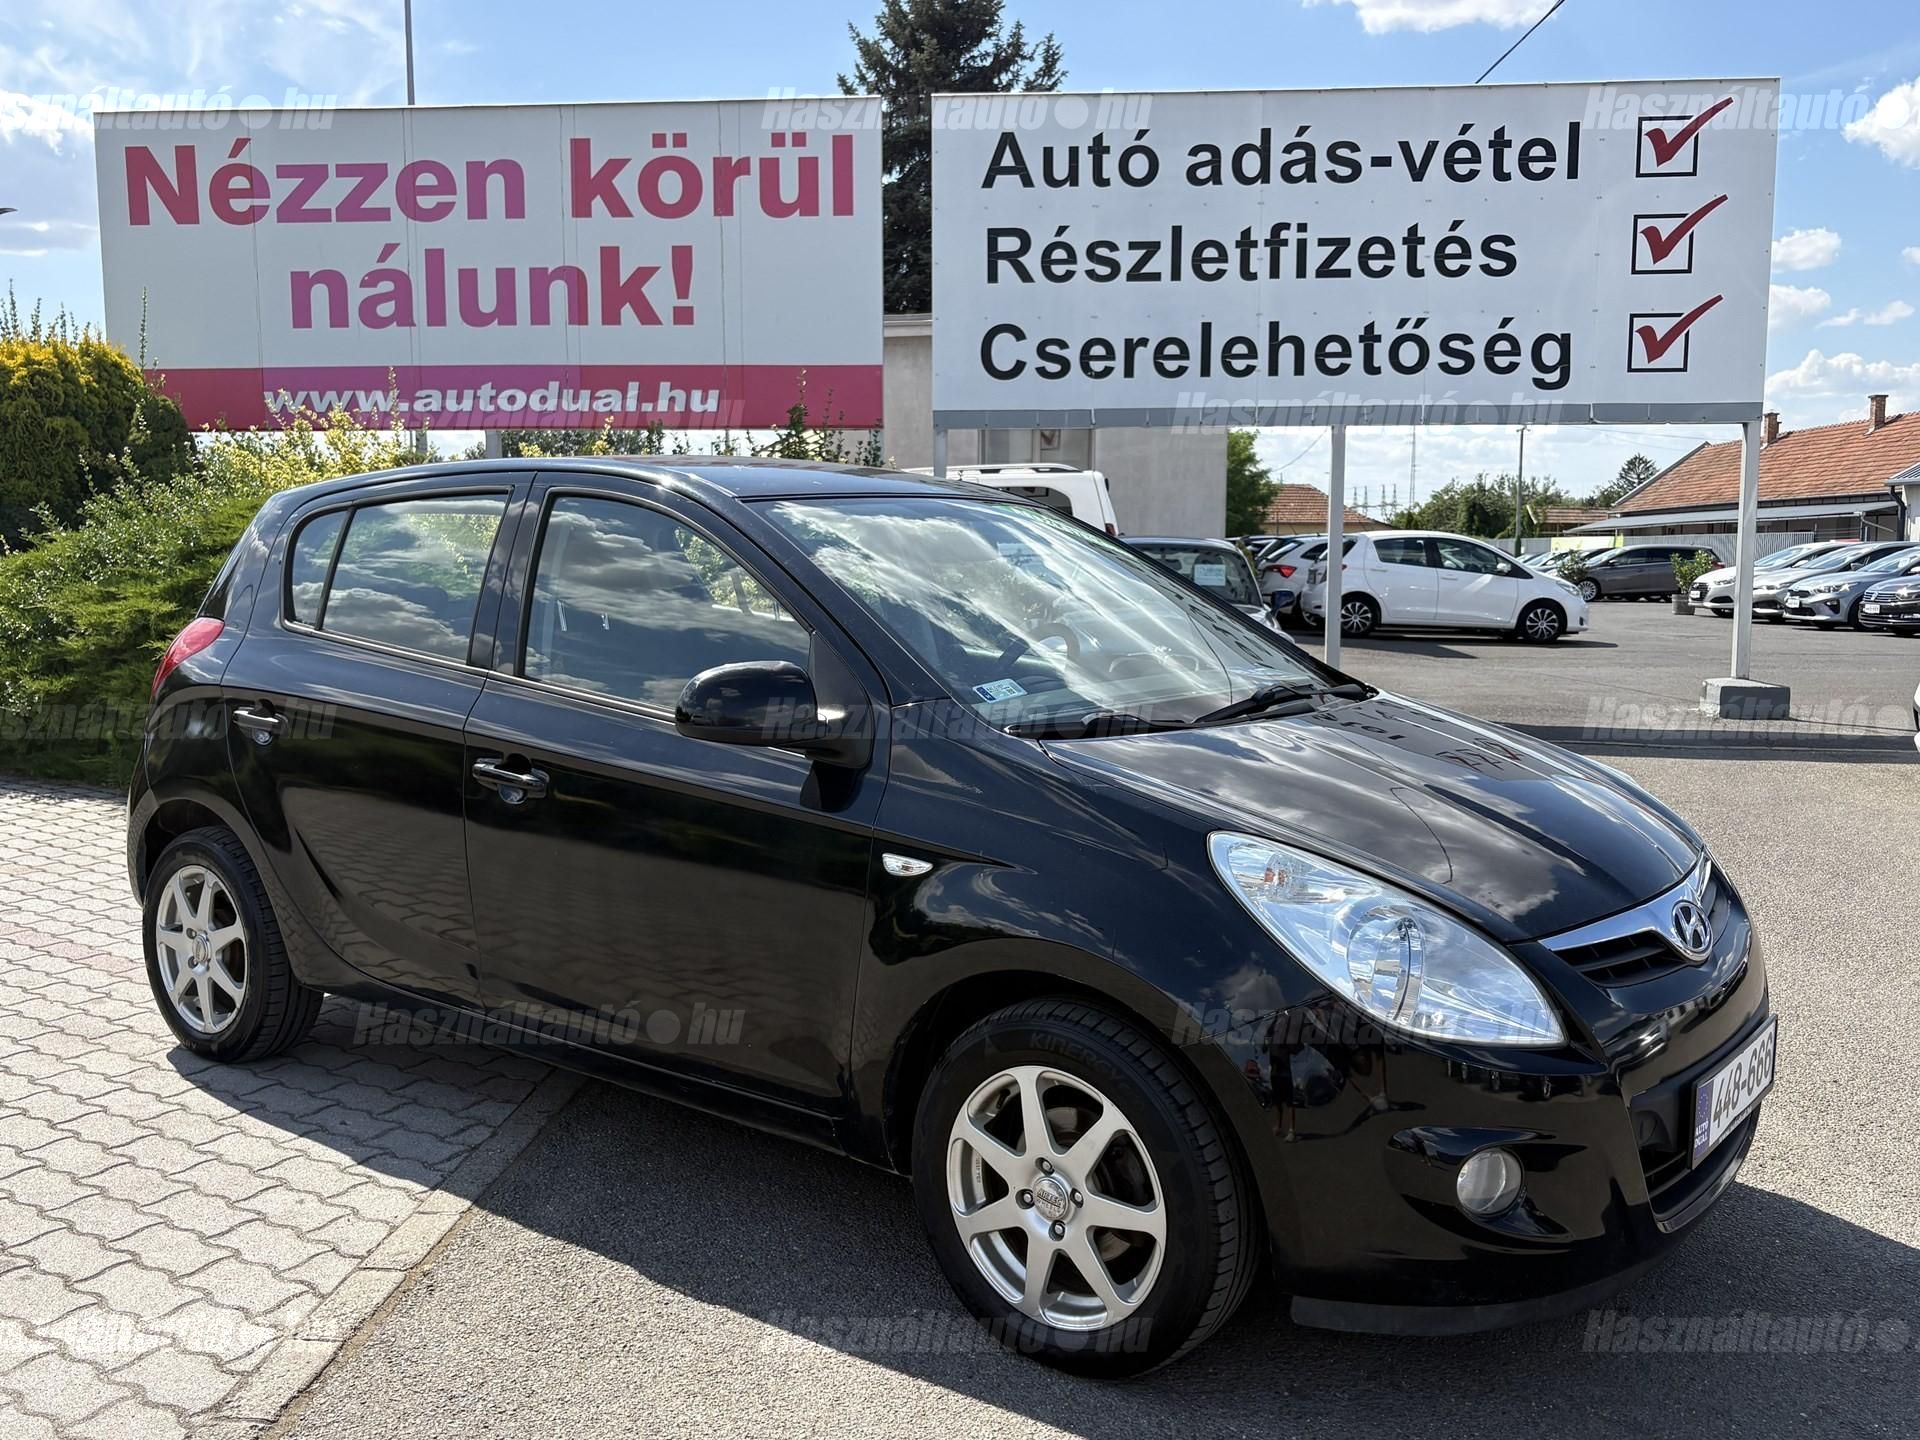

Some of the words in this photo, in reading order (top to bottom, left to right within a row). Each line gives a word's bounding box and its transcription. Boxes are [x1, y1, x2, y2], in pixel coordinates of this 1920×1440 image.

[124, 138, 526, 226] Nézzen
[570, 132, 855, 218] körül
[981, 128, 1160, 189] Autó
[1186, 121, 1580, 186] adás-vétel
[290, 243, 696, 329] nálunk!
[985, 218, 1518, 284] Részletfizetés
[979, 317, 1573, 391] Cserelehetőség
[263, 380, 720, 414] www.autodual.hu
